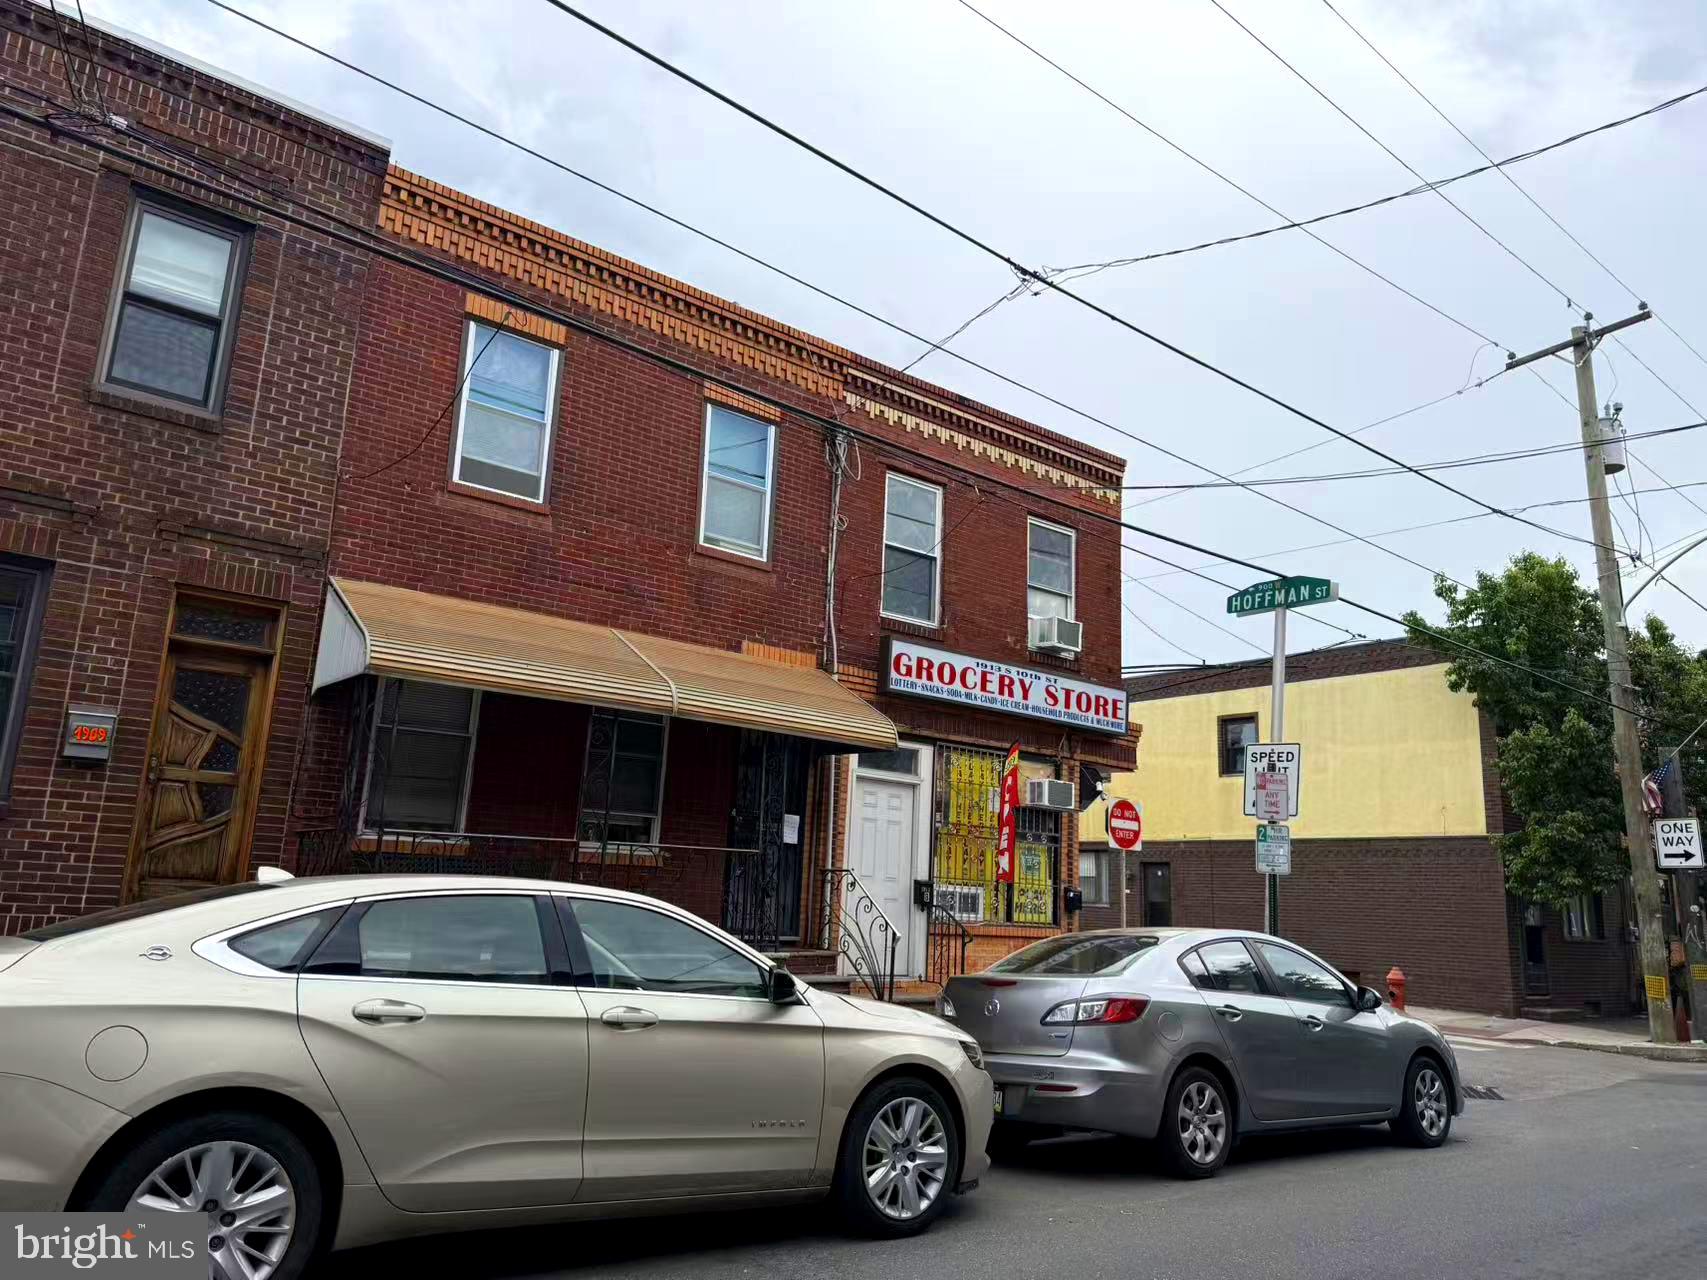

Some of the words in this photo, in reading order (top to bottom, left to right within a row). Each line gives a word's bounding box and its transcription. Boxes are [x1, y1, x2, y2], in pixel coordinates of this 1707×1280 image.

[1231, 584, 1310, 612] HOFFMAN
[1315, 586, 1328, 599] ST
[974, 661, 1002, 673] 1913
[1004, 667, 1012, 675] S
[1016, 670, 1041, 681] 10th
[1045, 675, 1059, 685] ST
[892, 652, 1034, 702] GROCERY
[1044, 684, 1125, 721] STORE
[74, 725, 108, 743] 1909
[1251, 751, 1295, 763] SPEED
[1265, 791, 1280, 799] ANY
[1264, 800, 1280, 809] TIME
[1112, 808, 1122, 816] DO
[1123, 809, 1136, 818] NOT
[1115, 829, 1135, 839] ENTER
[1258, 827, 1265, 840] 2
[1660, 822, 1694, 835] ONE
[1662, 835, 1694, 847] WAY
